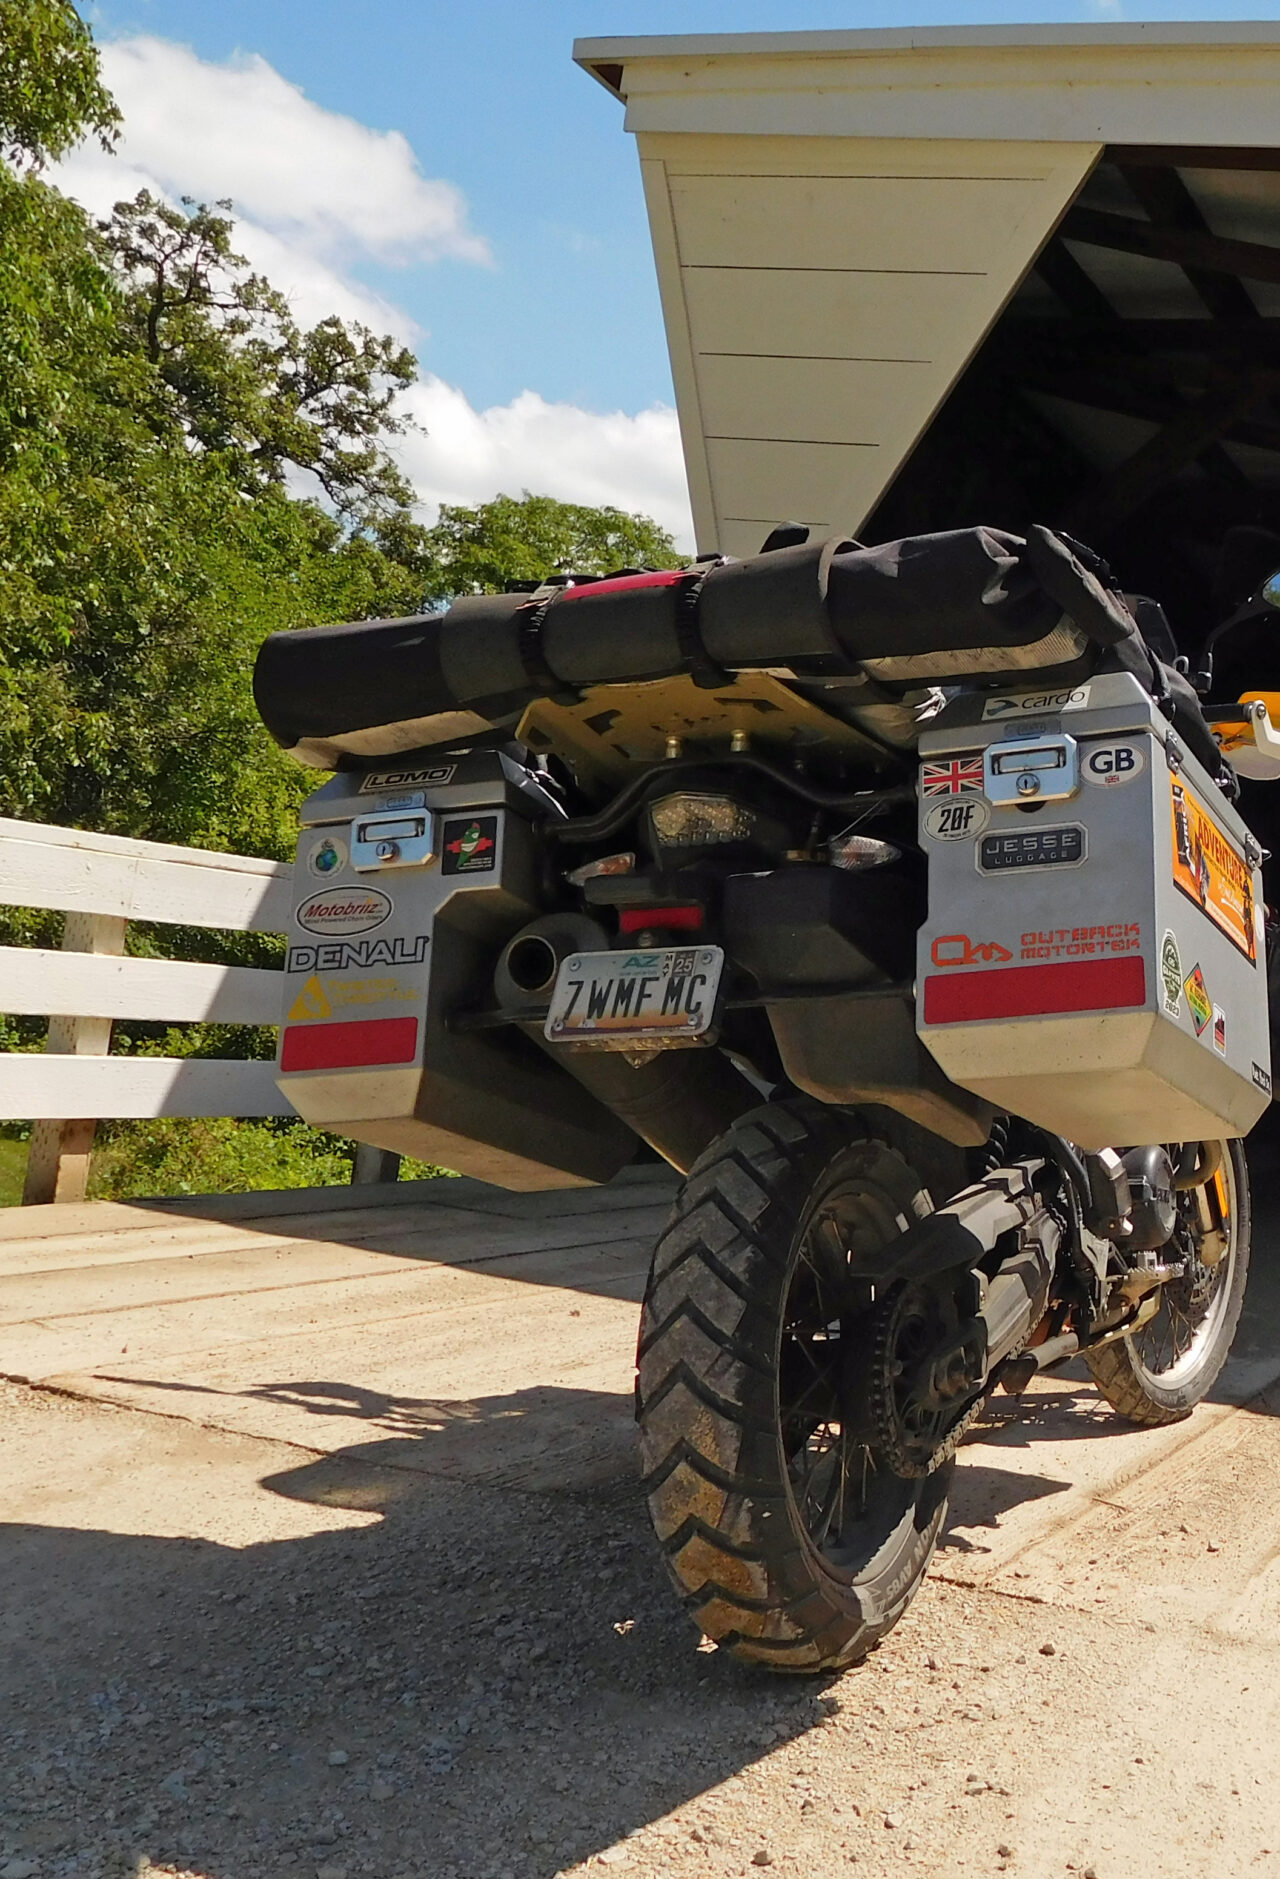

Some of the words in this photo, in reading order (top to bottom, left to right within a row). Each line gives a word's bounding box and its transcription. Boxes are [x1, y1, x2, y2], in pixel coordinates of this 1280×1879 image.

[1022, 687, 1086, 710] cardo
[1089, 748, 1135, 774] GB
[369, 768, 446, 787] LOMO
[986, 833, 1078, 854] JESSE
[1196, 815, 1245, 889] ADVENTURE
[994, 850, 1069, 865] LUGGAGE
[1020, 923, 1141, 945] OUTBACK
[288, 936, 427, 973] DENALI
[1020, 938, 1141, 960] MOTORTEK
[622, 955, 661, 968] AZ
[674, 958, 693, 973] 25
